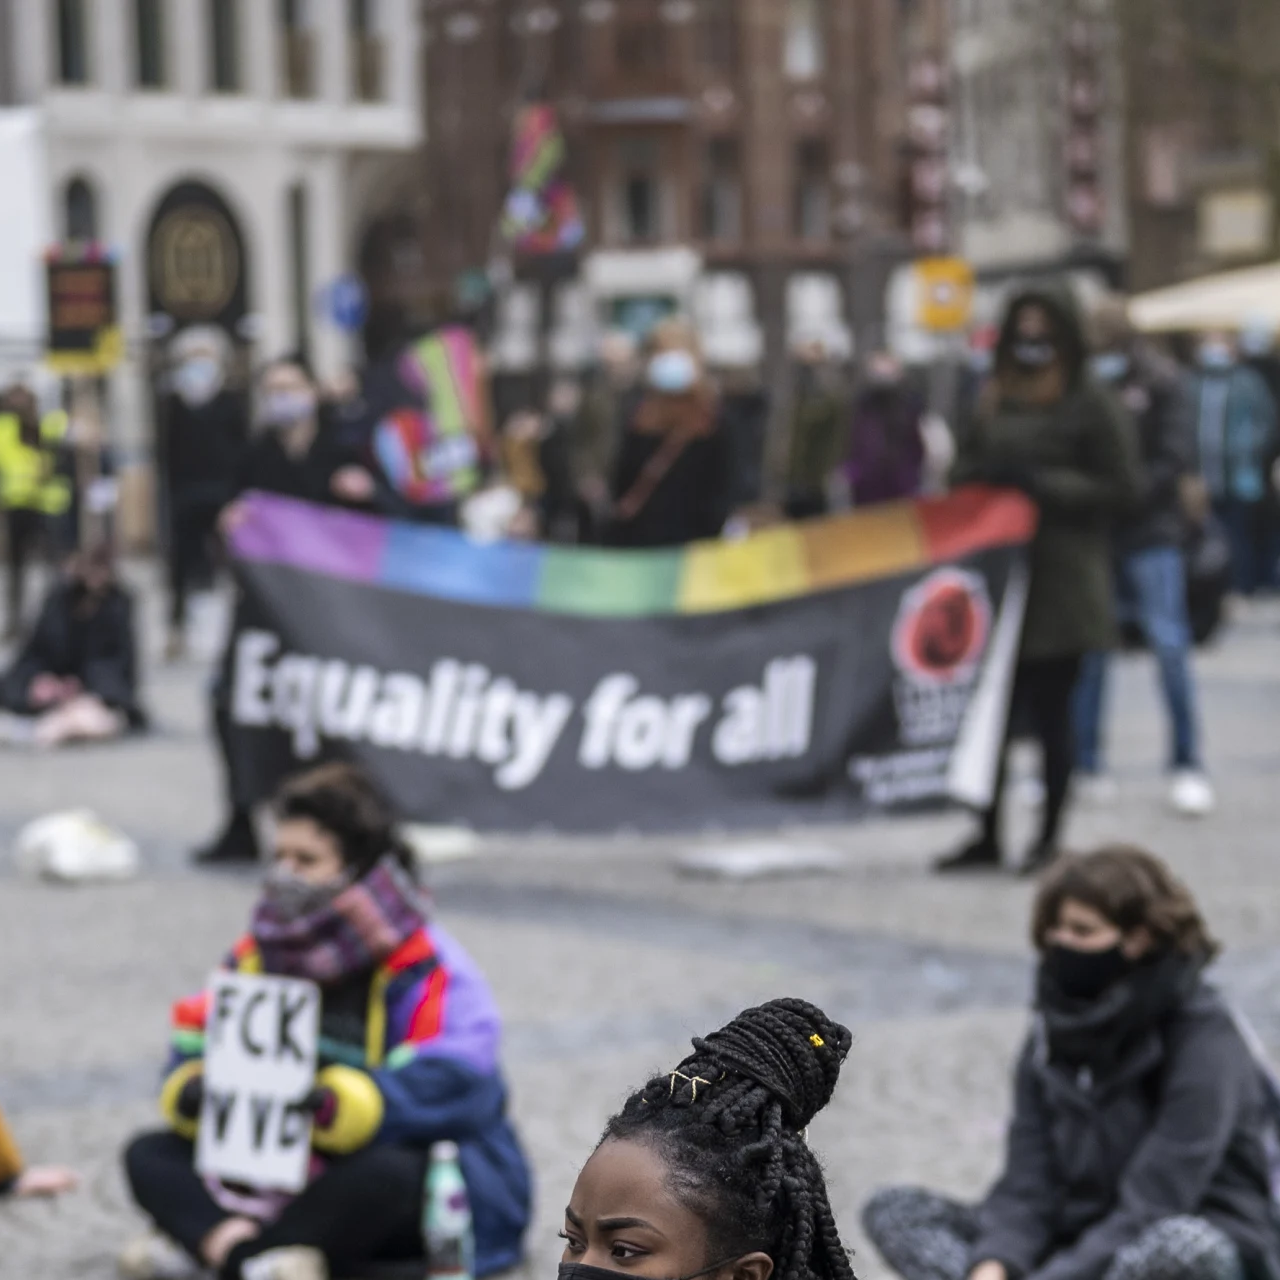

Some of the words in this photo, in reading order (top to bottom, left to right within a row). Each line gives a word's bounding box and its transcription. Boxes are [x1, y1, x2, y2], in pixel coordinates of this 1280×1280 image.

[231, 628, 573, 790] Equality
[577, 671, 714, 771] for
[712, 654, 817, 765] all
[213, 985, 309, 1062] FCK
